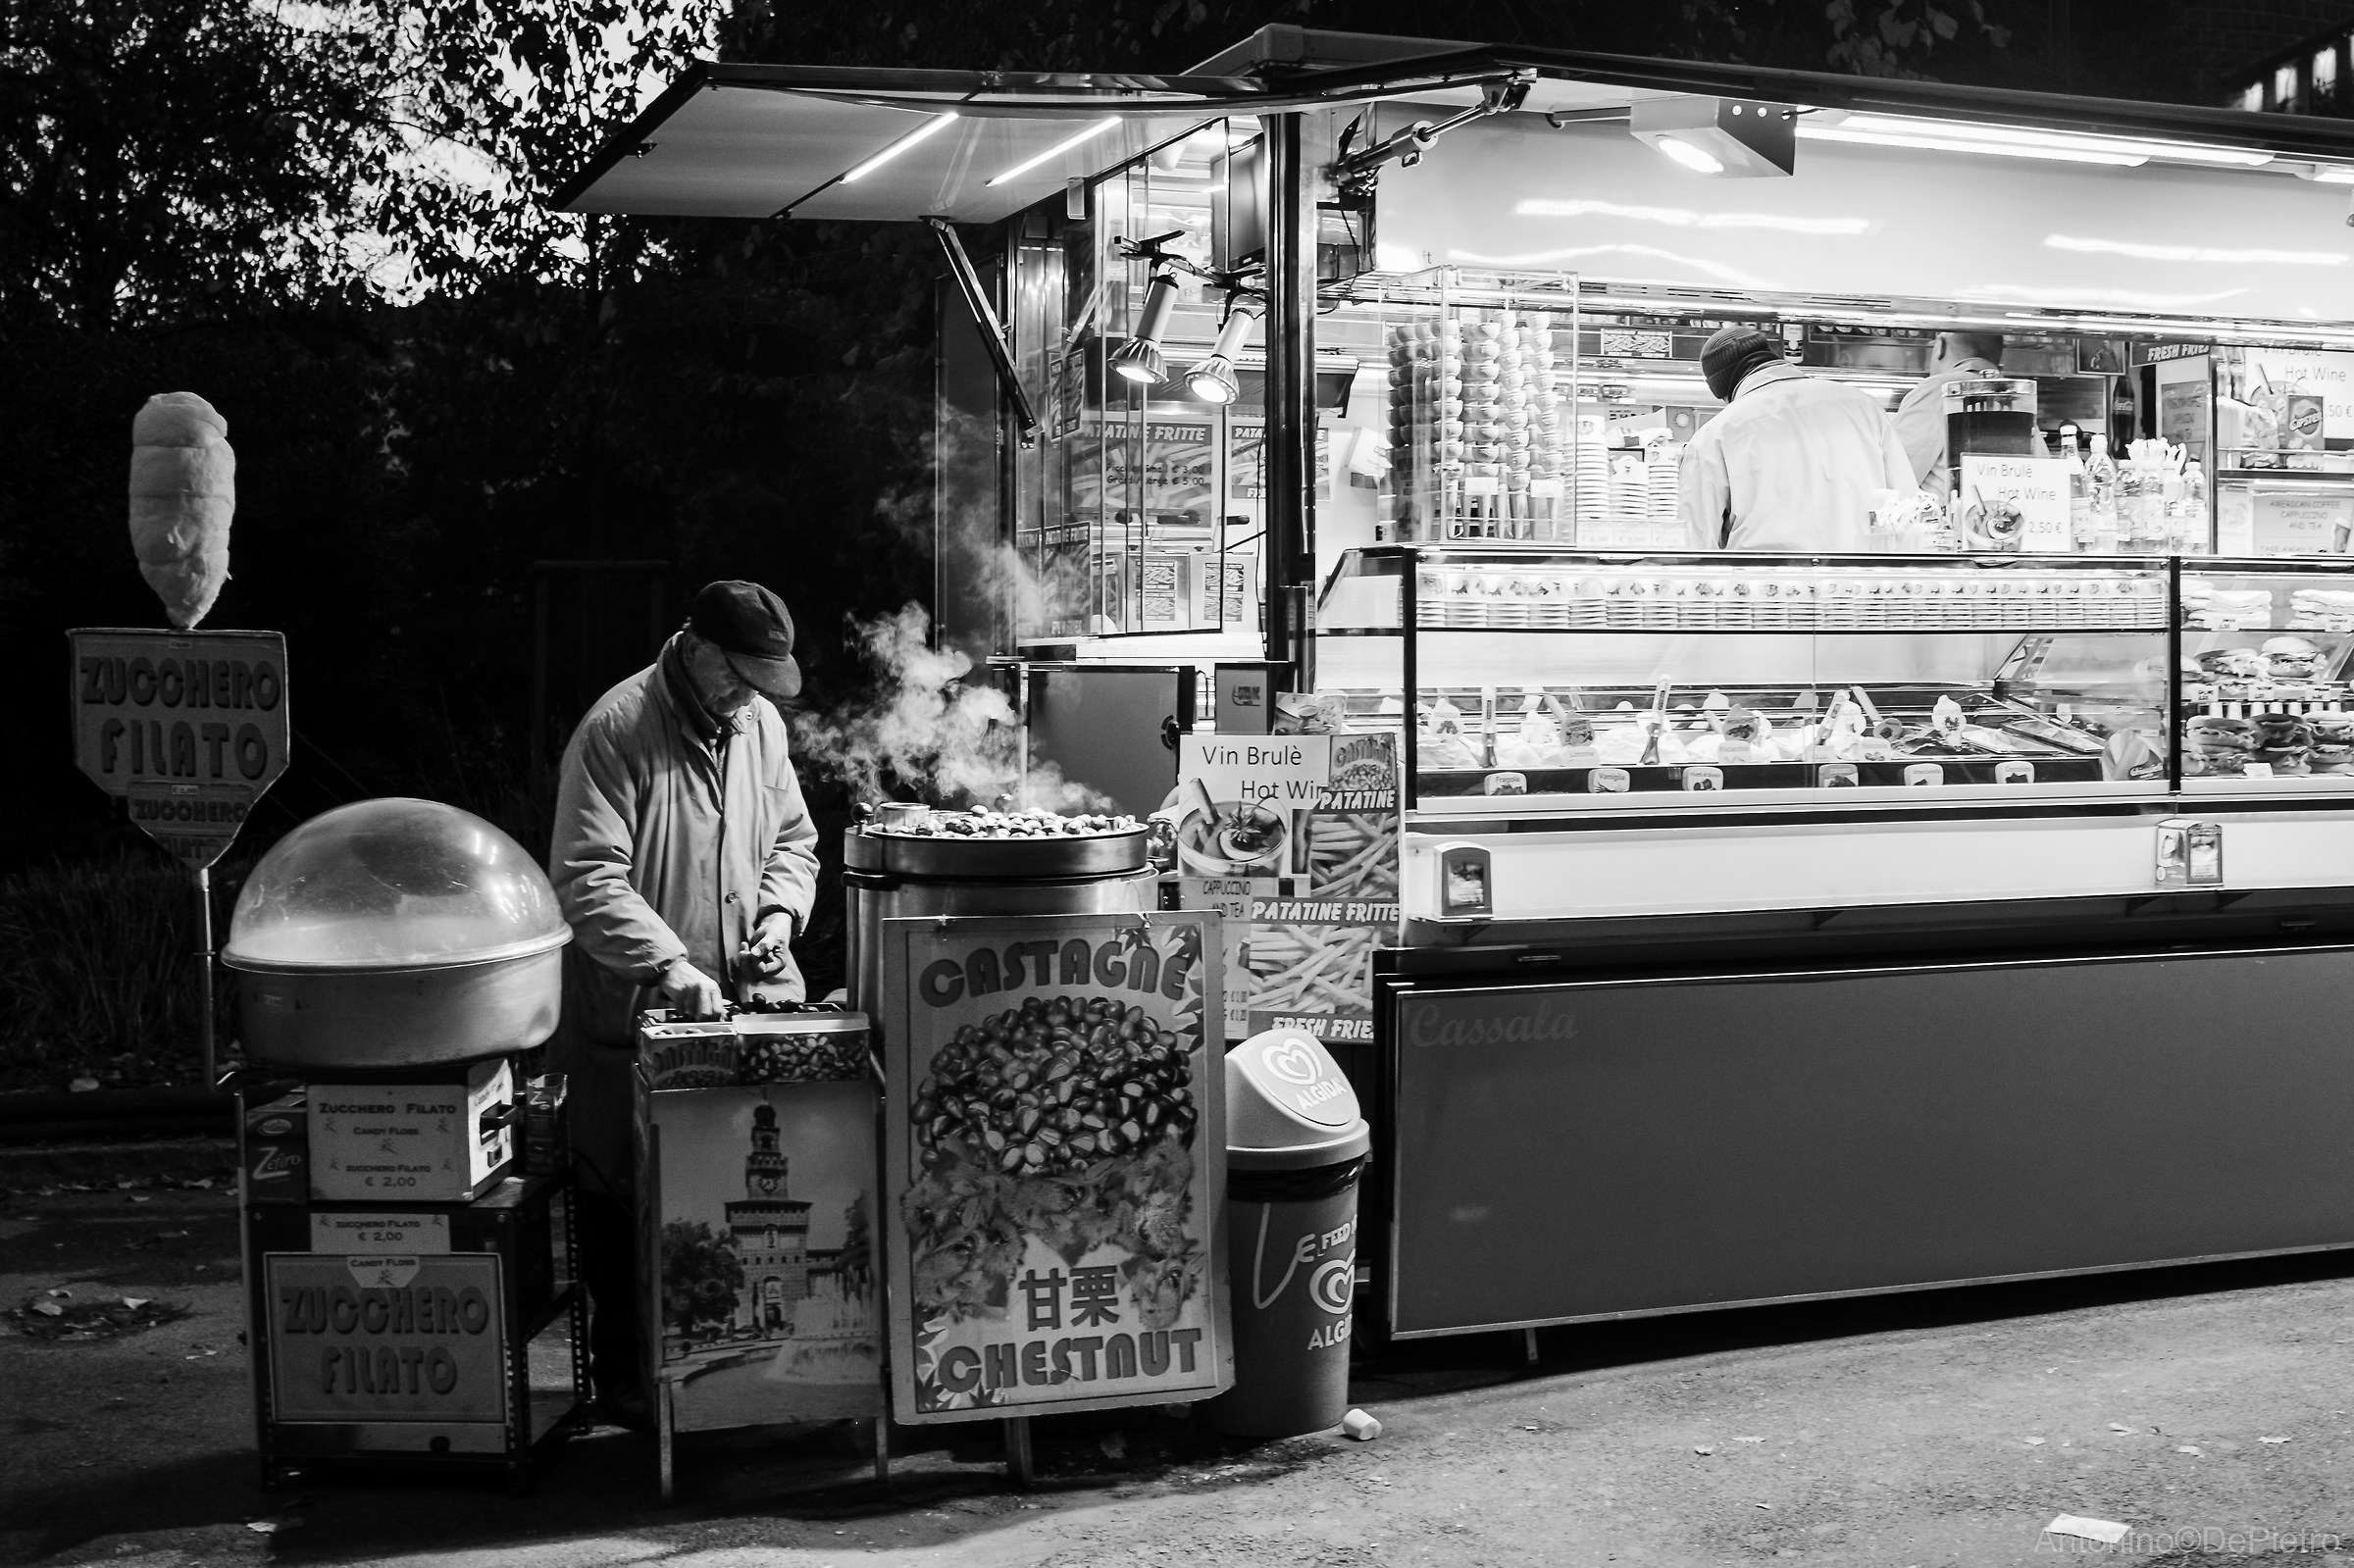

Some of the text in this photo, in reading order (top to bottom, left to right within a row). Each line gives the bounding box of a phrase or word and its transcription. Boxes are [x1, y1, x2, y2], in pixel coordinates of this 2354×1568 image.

[2147, 344, 2180, 362] FRESH
[2284, 366, 2346, 381] Hot Wine
[2324, 405, 2342, 419] ,50
[1153, 426, 1206, 441] FRITTE
[1976, 463, 2033, 479] Vin Brulè
[1998, 486, 2057, 501] Hot Wine
[2056, 522, 2063, 534] €
[79, 656, 281, 712] ZUCCHERO
[101, 717, 269, 781] FILATO
[1202, 745, 1303, 765] Vin Brulè
[1241, 781, 1279, 799] Hot
[1318, 789, 1396, 811] PATATINE
[134, 799, 246, 823] ZUCCHERO
[1203, 881, 1252, 896] CAPPUCCINO
[1230, 902, 1245, 918] TEA
[1251, 901, 1400, 923] PATATINE FRITTE
[919, 938, 1188, 1008] CASTAGNE
[1272, 1017, 1374, 1039] FRESH FRIE
[1409, 998, 1578, 1048] Cassala
[1295, 1077, 1348, 1111] ALGIDA
[318, 1103, 457, 1115] ZUCCHERO FILATO
[252, 1145, 302, 1181] Zefiro
[365, 1177, 375, 1188] €
[358, 1232, 367, 1241] €
[1321, 1222, 1352, 1250] FEED
[1018, 1264, 1120, 1333] 甘栗
[280, 1286, 489, 1336] ZUCCHERO
[1306, 1313, 1353, 1351] ALGI
[321, 1345, 458, 1395] FILATO
[939, 1327, 1202, 1393] CHESTNUT
